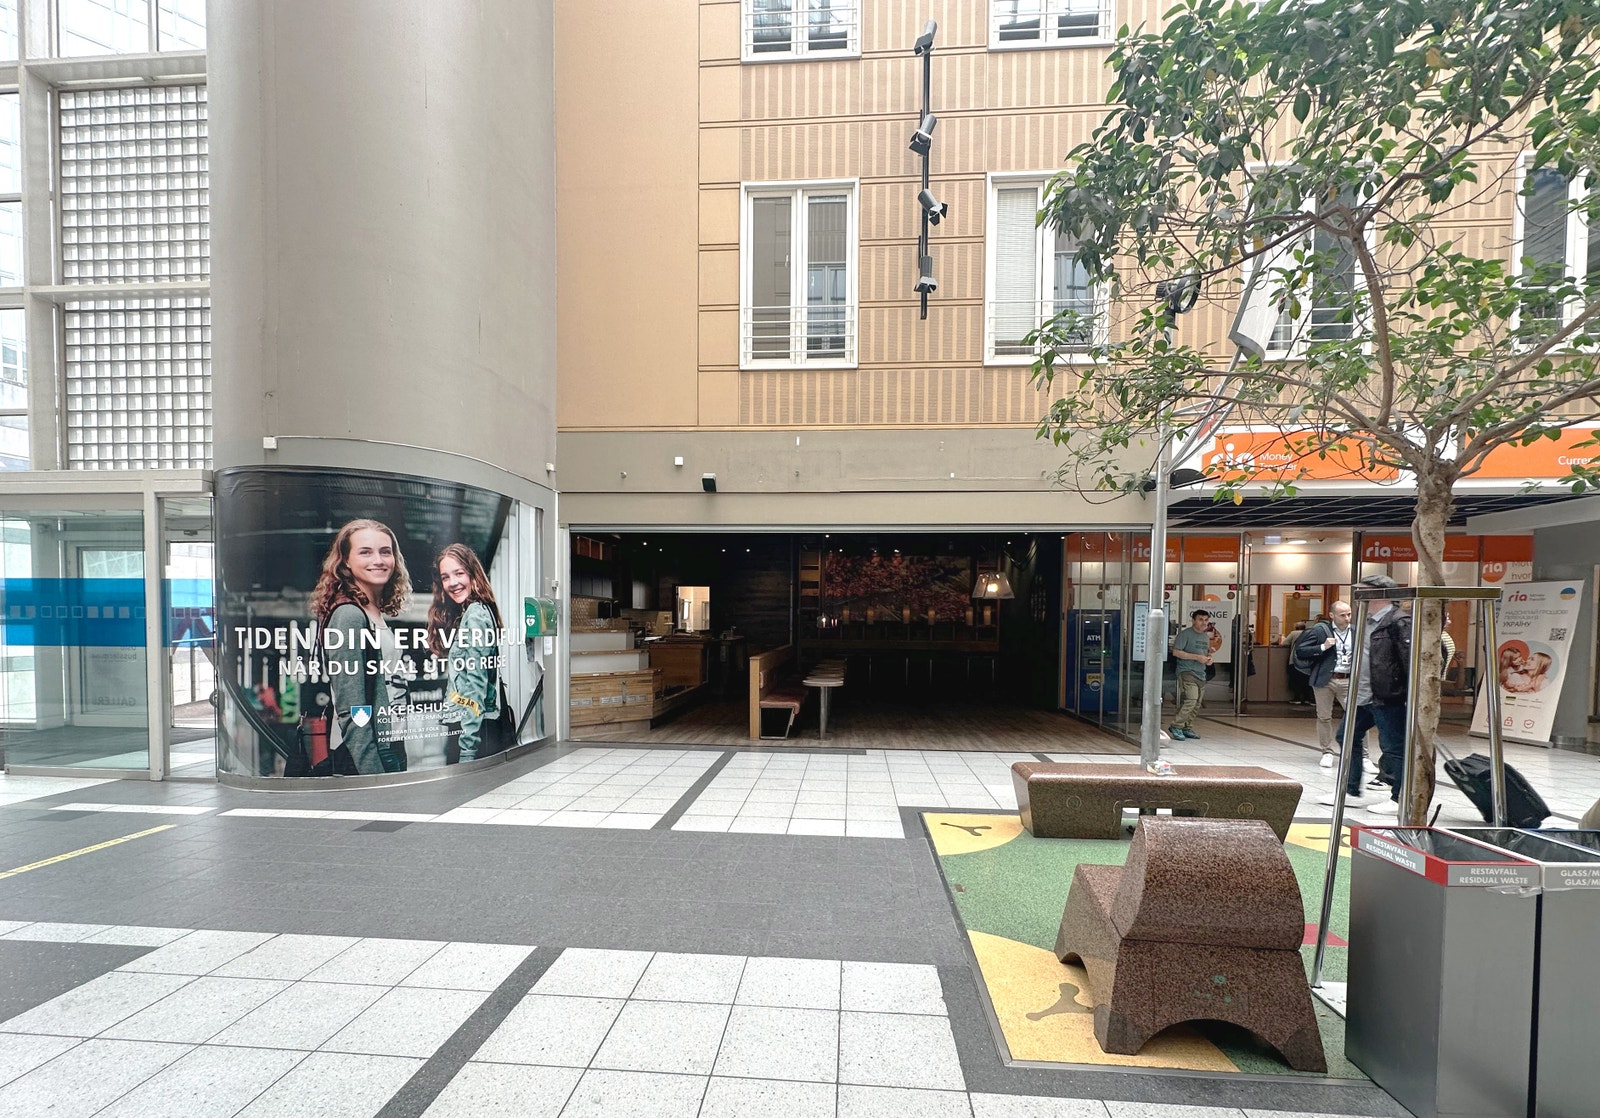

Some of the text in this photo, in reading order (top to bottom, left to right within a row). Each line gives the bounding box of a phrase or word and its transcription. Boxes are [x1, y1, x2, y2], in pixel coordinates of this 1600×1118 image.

[1259, 452, 1293, 463] Money
[1365, 541, 1391, 557] ria
[1508, 590, 1528, 602] ria
[1190, 611, 1228, 619] CNGE
[234, 627, 312, 650] TIDEN
[323, 627, 382, 650] DIN
[393, 628, 430, 650] ER
[278, 655, 507, 676] NÅR DU SKAL UT OG REISE
[376, 702, 450, 717] AKERSHUS
[465, 699, 475, 708] ÅR
[1373, 838, 1408, 858] RESTAVFALL
[1365, 843, 1417, 870] RESIDUAL WASTE
[1470, 867, 1517, 875] RESTAVFALL
[1459, 876, 1528, 885] RESIDUAL WASTE
